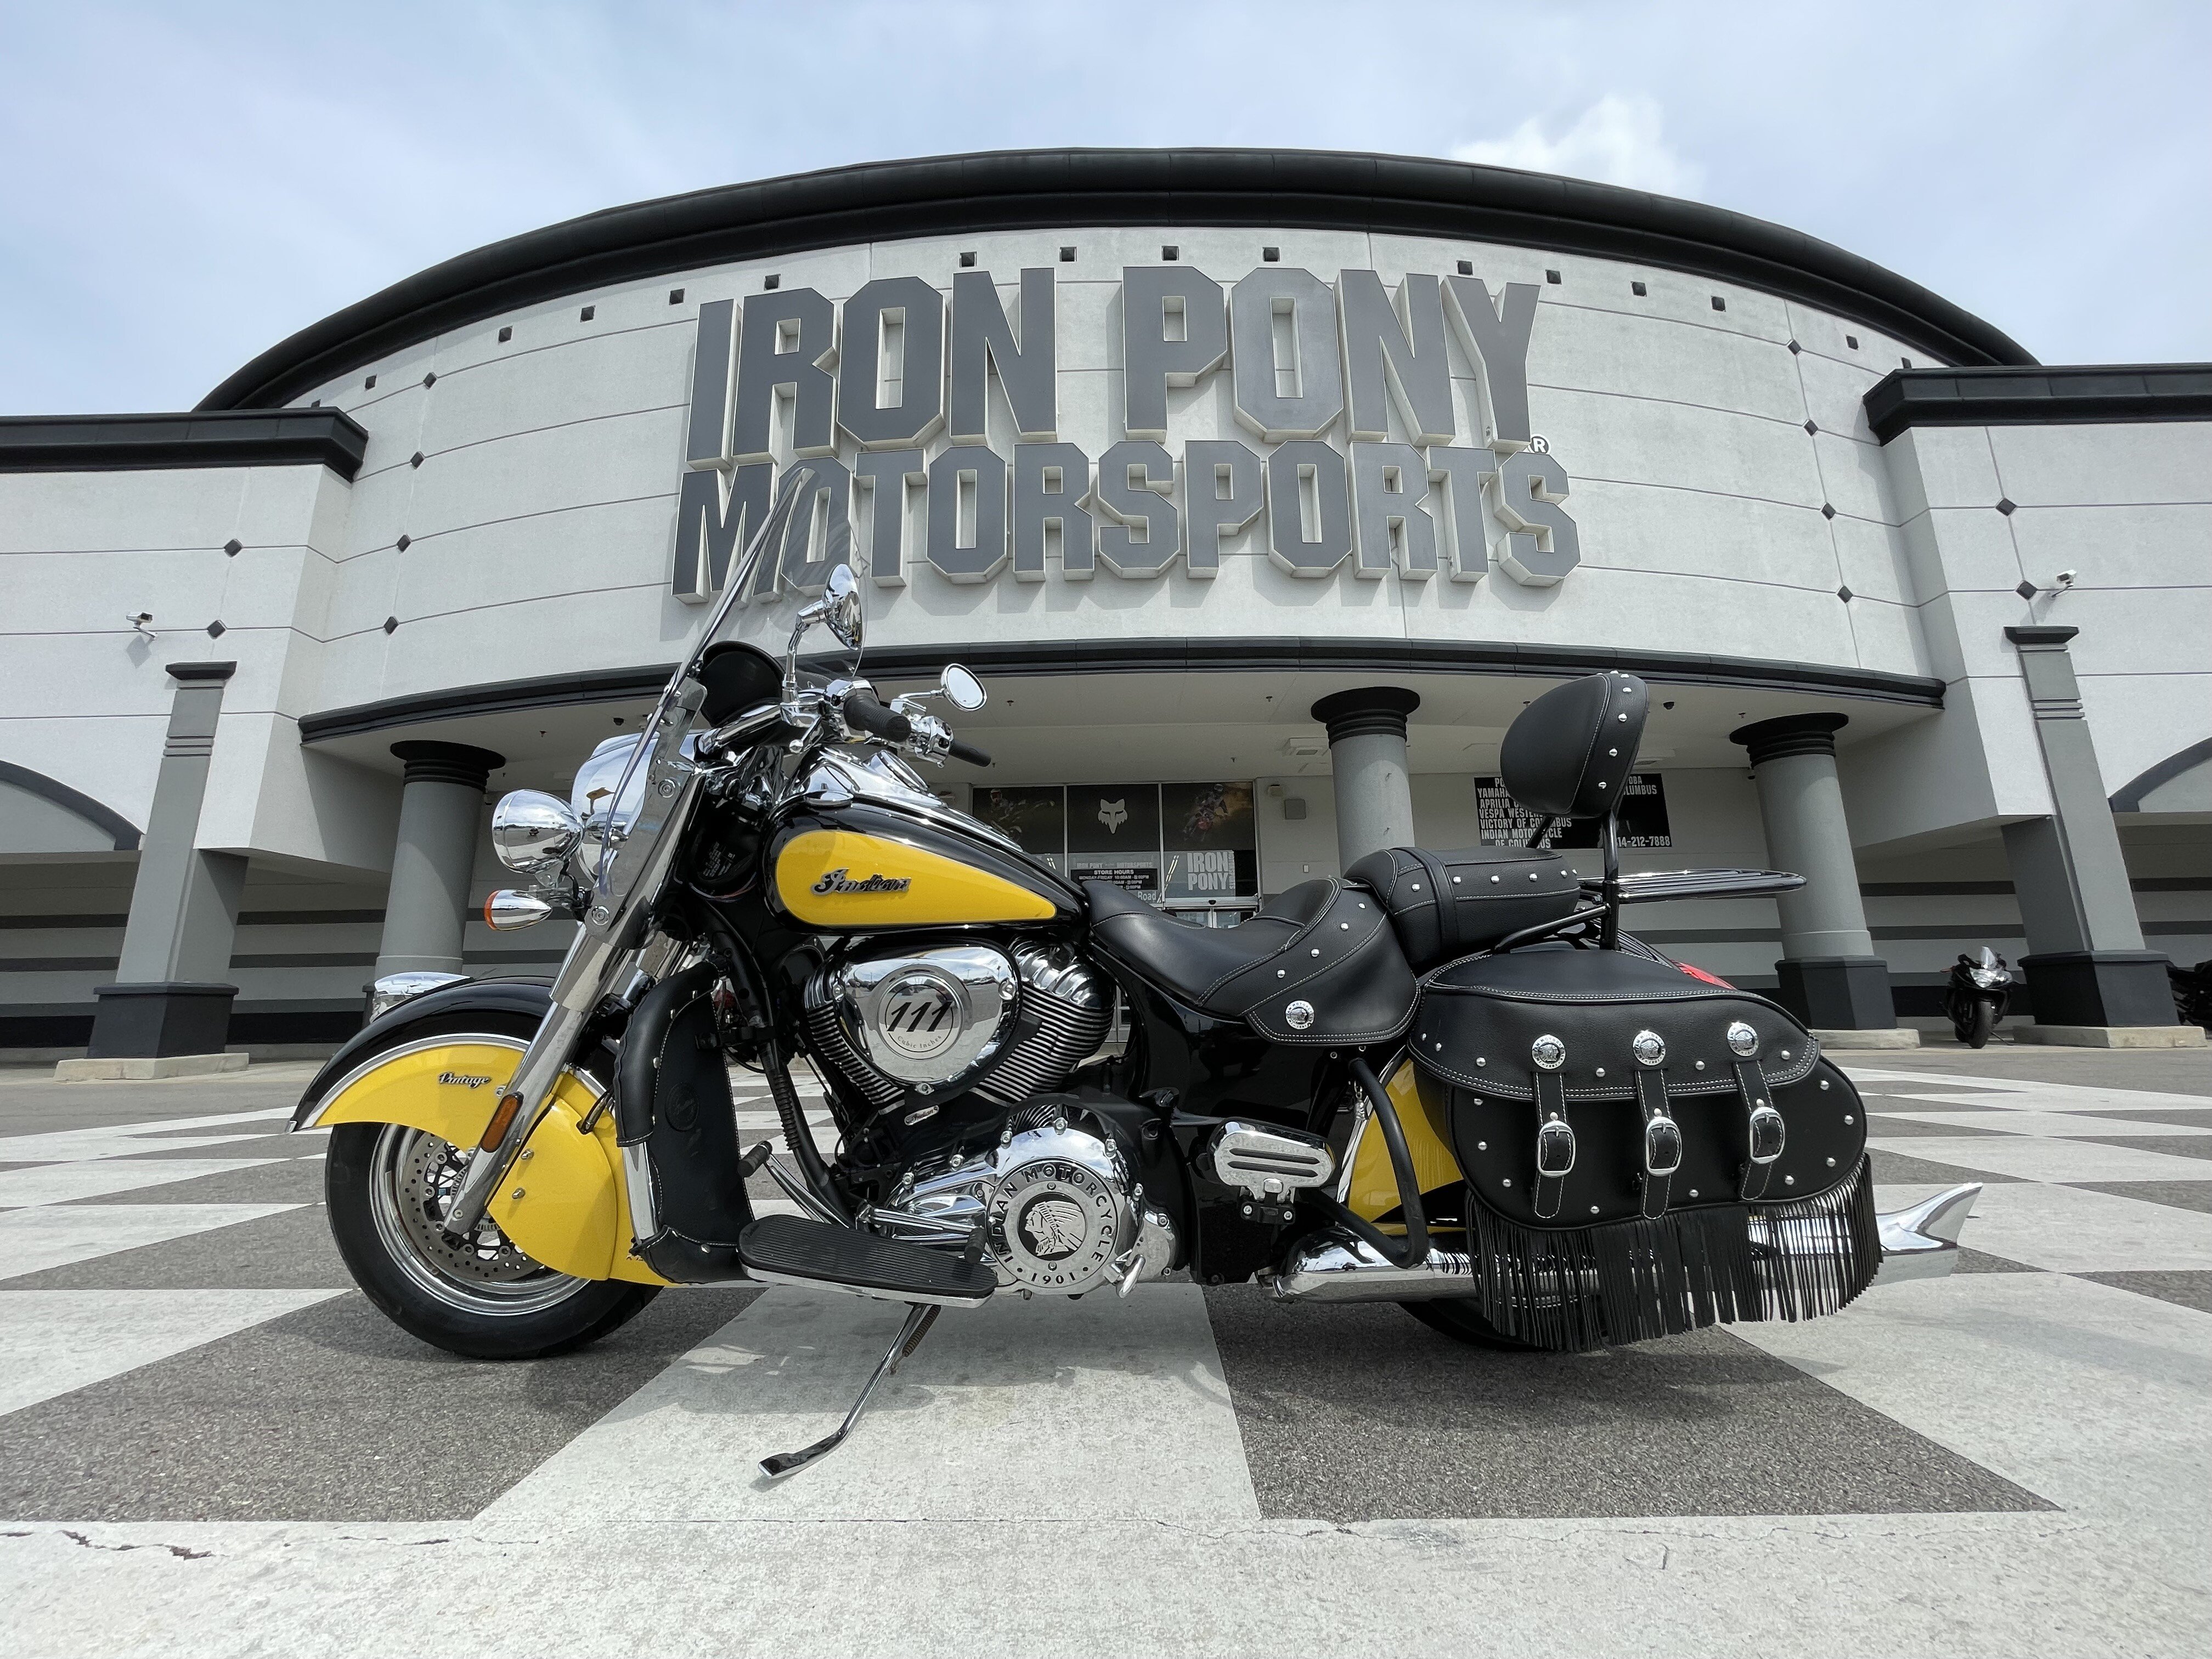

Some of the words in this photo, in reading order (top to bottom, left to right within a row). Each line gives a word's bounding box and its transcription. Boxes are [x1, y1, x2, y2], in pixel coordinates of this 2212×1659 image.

[687, 267, 1058, 470] IRON
[1121, 266, 1541, 453] PONY
[670, 440, 1581, 606] MOTORSPORTS
[1623, 785, 1657, 795] LUMBUS
[1480, 798, 1510, 809] APRILIA
[1479, 808, 1504, 819] VESPA
[1480, 818, 1513, 830] VICTORY
[1516, 818, 1527, 829] OF
[1530, 817, 1572, 828] COBUS
[1481, 829, 1509, 840] INDIAN
[1511, 827, 1562, 839] MOTOCLE
[1508, 838, 1551, 849] COLUUS
[1617, 836, 1671, 848] 14-212-7888
[1187, 851, 1229, 872] IRON
[810, 867, 911, 896] Indian
[1187, 872, 1229, 890] PONY
[1137, 890, 1157, 901] Road
[886, 1001, 953, 1032] 111
[897, 1035, 917, 1048] Cubic
[919, 1035, 942, 1048] Inches
[438, 1071, 492, 1088] Vintage
[991, 1181, 1018, 1263] INDIAN
[1023, 1163, 1113, 1262] MOTORCYCLE
[1031, 1271, 1076, 1284] 1901
